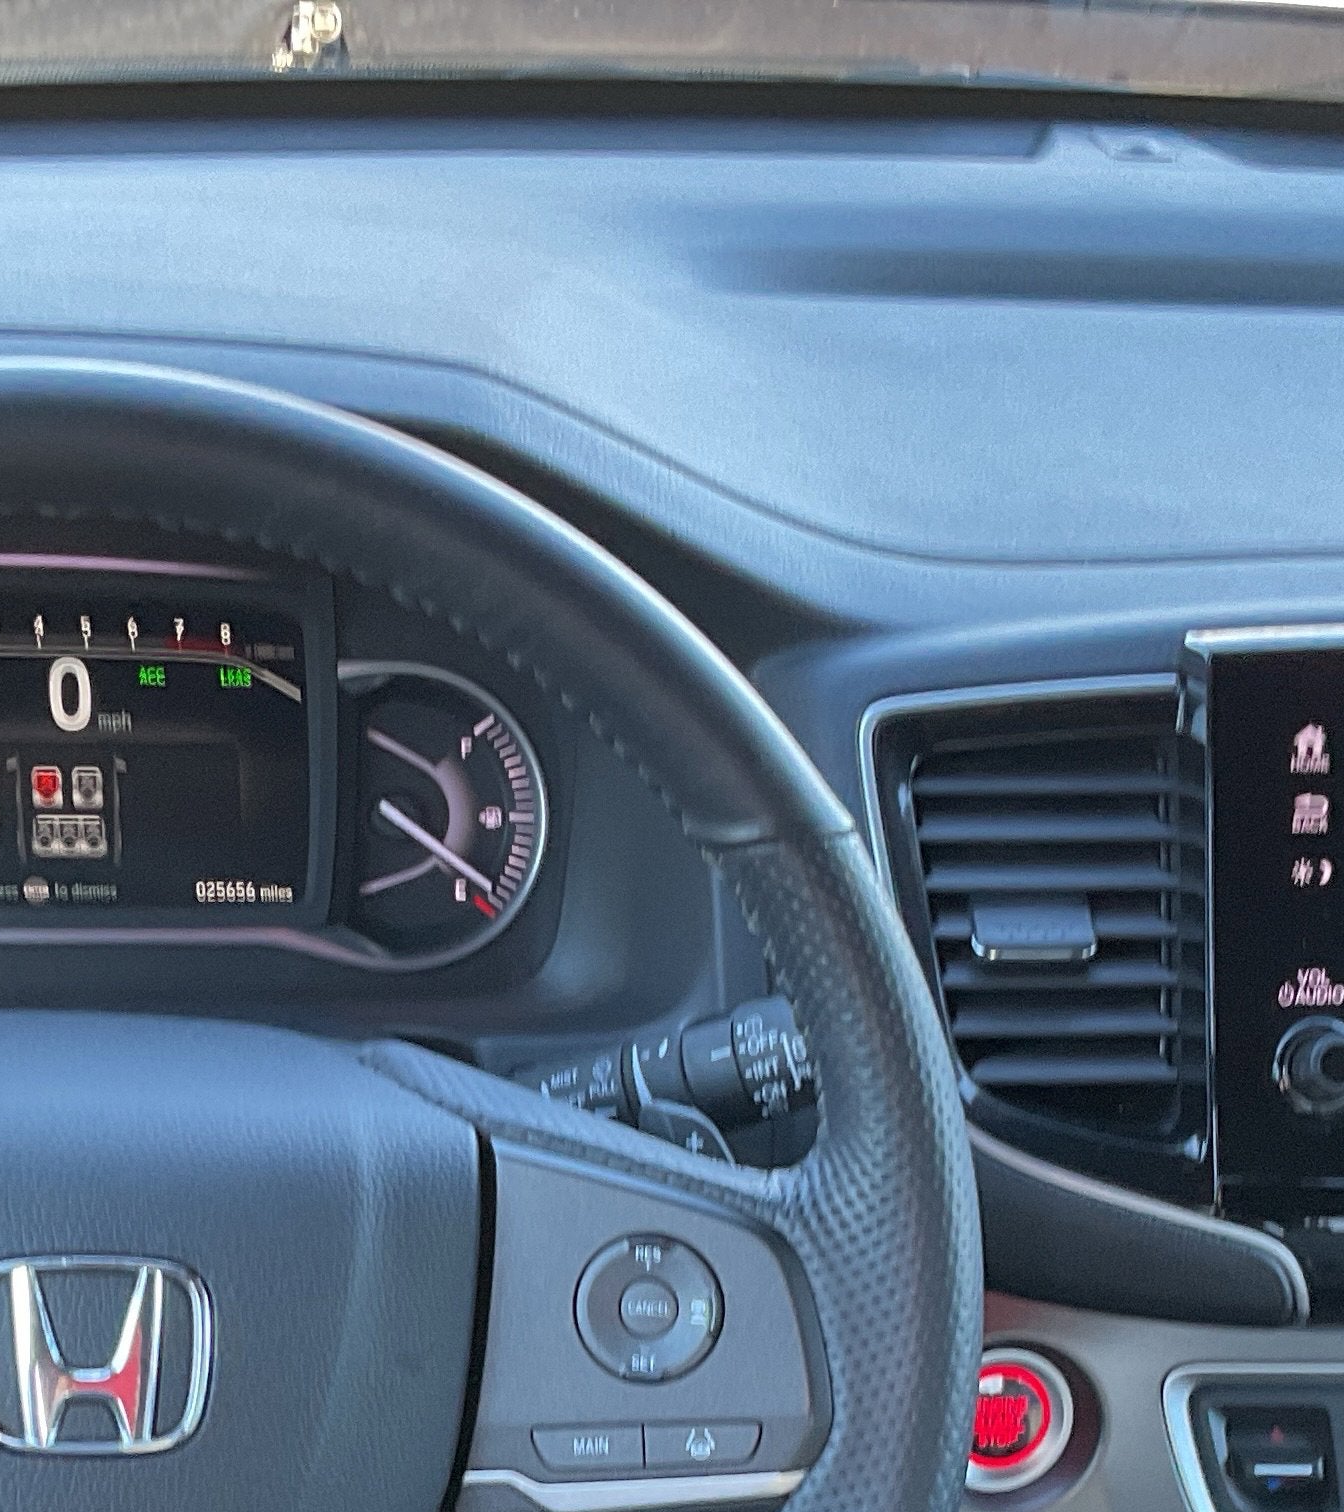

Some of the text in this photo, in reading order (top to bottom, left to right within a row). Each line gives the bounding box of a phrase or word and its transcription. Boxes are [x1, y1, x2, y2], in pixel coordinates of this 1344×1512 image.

[174, 618, 184, 641] 7
[220, 622, 231, 645] 8
[219, 667, 251, 688] LKAS
[49, 656, 132, 733] 0 mph
[71, 881, 118, 902] dismiss
[195, 881, 293, 903] 025656 miles
[1297, 968, 1330, 988] VOL
[573, 1437, 609, 1456] MAIN
